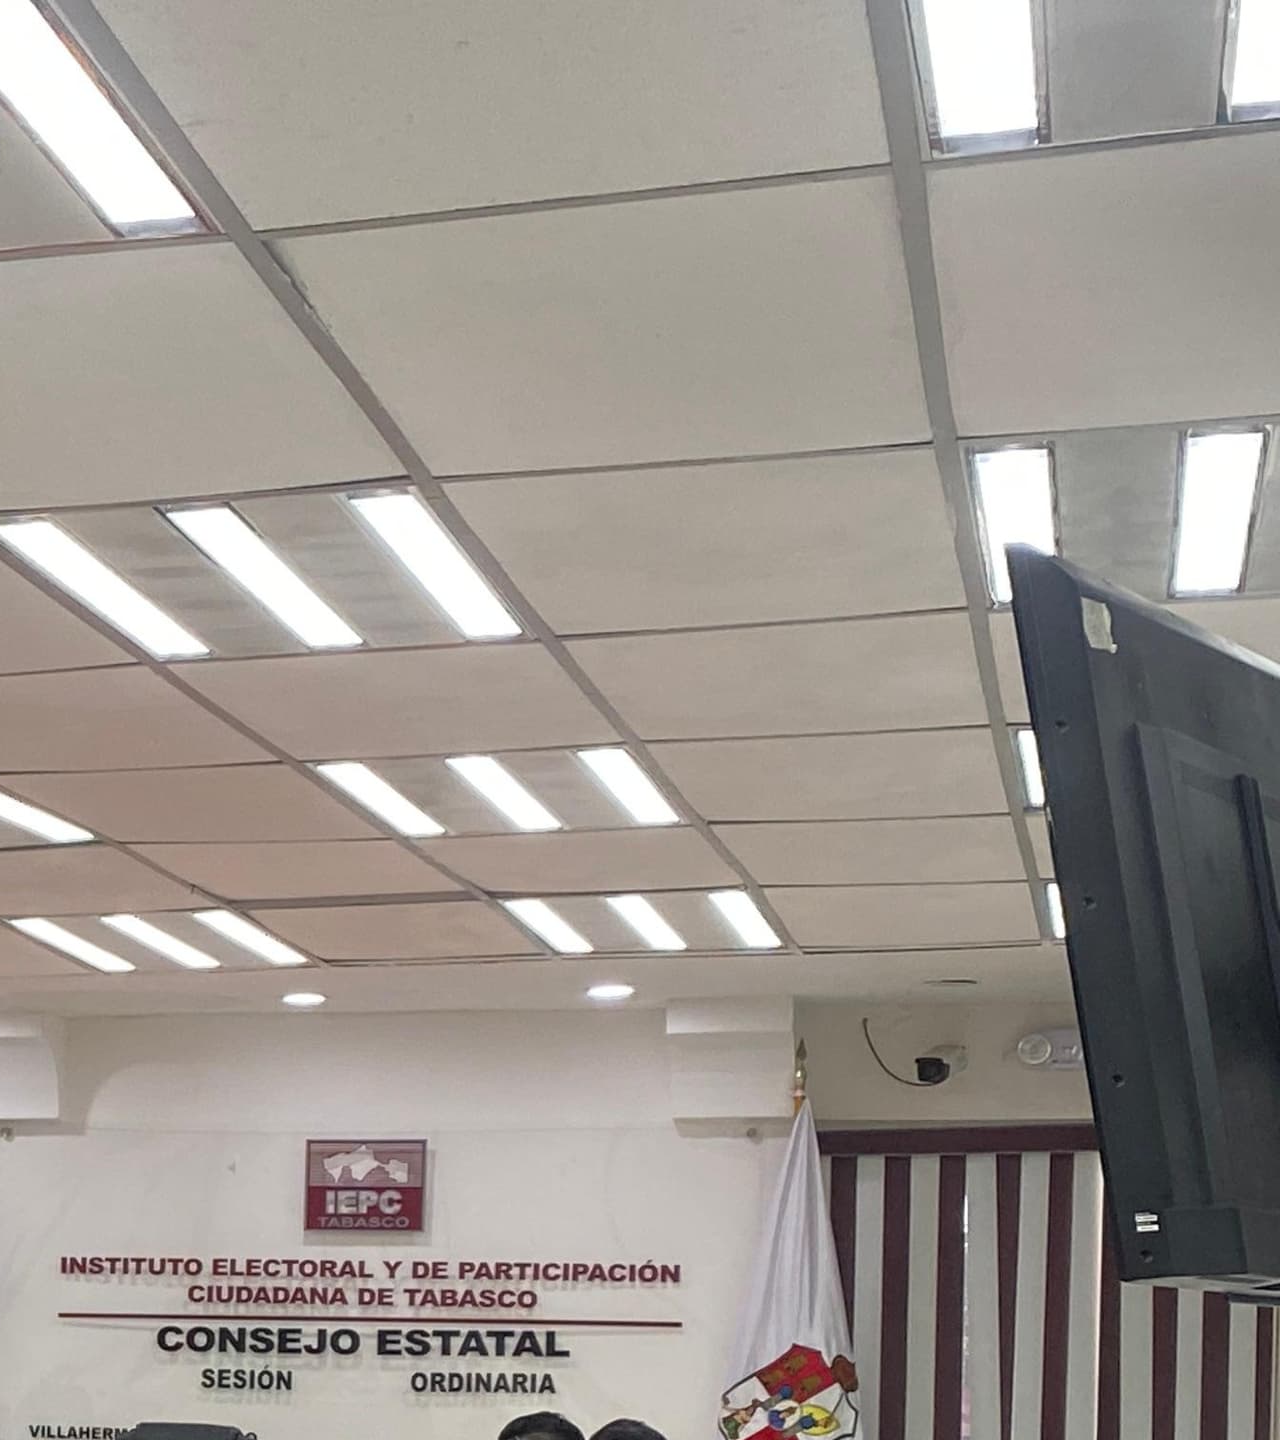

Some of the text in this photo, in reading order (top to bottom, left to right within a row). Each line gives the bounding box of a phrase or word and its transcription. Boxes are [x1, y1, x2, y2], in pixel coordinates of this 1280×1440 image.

[325, 1189, 403, 1215] IEPC
[317, 1215, 410, 1229] TABASCO
[59, 1256, 682, 1284] INSTITUTO ELECTORAL Y DE PARTICIPACIÓN
[187, 1284, 538, 1309] CIUDADANA DE TABASCO
[156, 1325, 571, 1359] CONSEJO ESTATAL
[200, 1365, 293, 1391] SESIÓN
[410, 1372, 557, 1395] ORDINARIA
[28, 1424, 128, 1440] VILLAHERM
